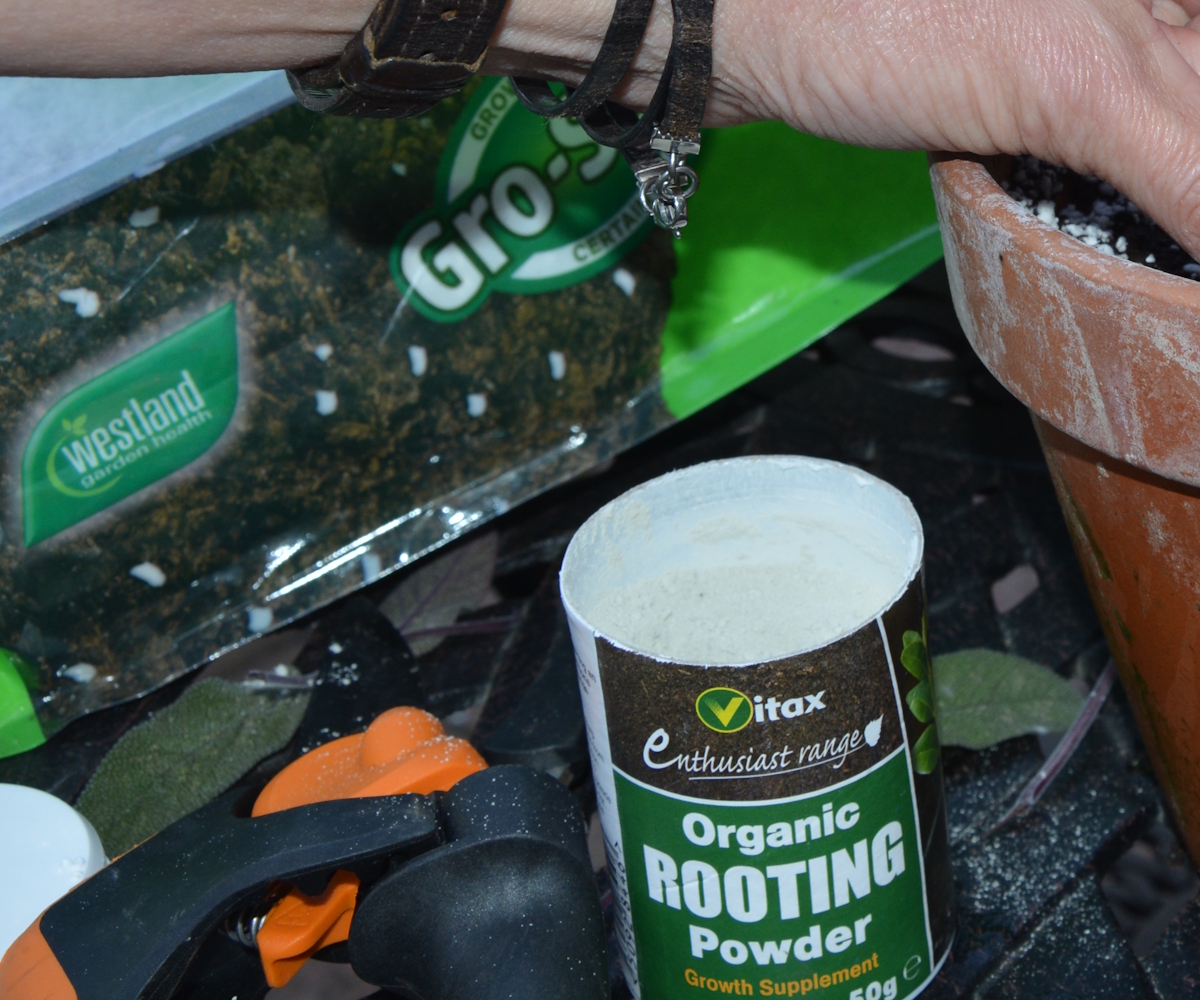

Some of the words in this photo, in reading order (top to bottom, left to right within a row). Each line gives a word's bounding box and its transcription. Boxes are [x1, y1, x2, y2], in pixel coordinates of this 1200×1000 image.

[400, 117, 618, 310] Gro-S
[80, 445, 149, 489] garden
[152, 410, 213, 447] health
[642, 728, 794, 773] enthusiast
[799, 729, 864, 769] range
[682, 802, 861, 856] Organic
[642, 821, 906, 923] ROOTING
[688, 914, 873, 966] Powder
[684, 968, 754, 996] Growth
[759, 952, 880, 997] Supplement
